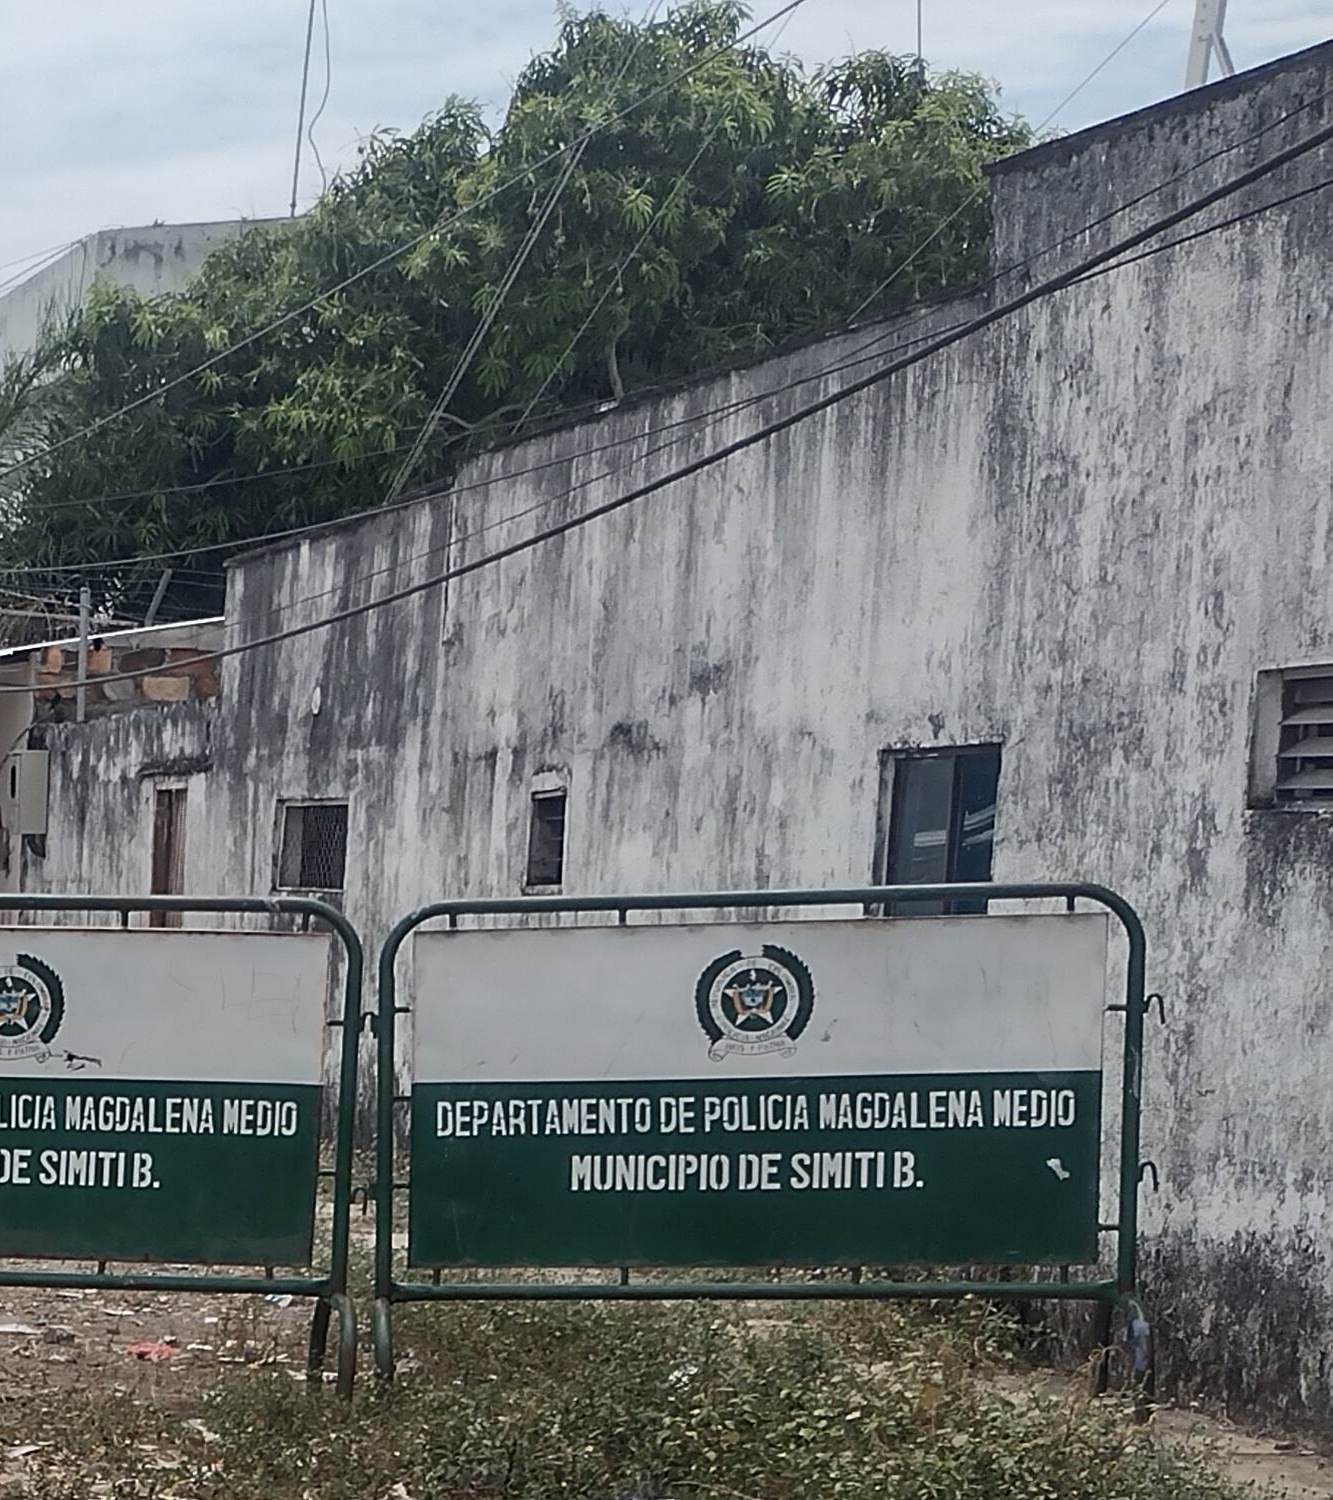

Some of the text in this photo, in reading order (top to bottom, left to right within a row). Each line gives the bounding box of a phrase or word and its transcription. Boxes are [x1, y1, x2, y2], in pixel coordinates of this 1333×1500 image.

[66, 1096, 213, 1133] MAGDALENA
[223, 1100, 296, 1135] MEDIO
[437, 1090, 1074, 1136] DEPARTAMENTO DE POLICIA MAGDALENA MEDIO
[40, 1151, 125, 1186] SIMITI
[572, 1155, 729, 1190] MUNICIPIO
[739, 1154, 781, 1189] DE
[791, 1152, 884, 1188] SIMITI
